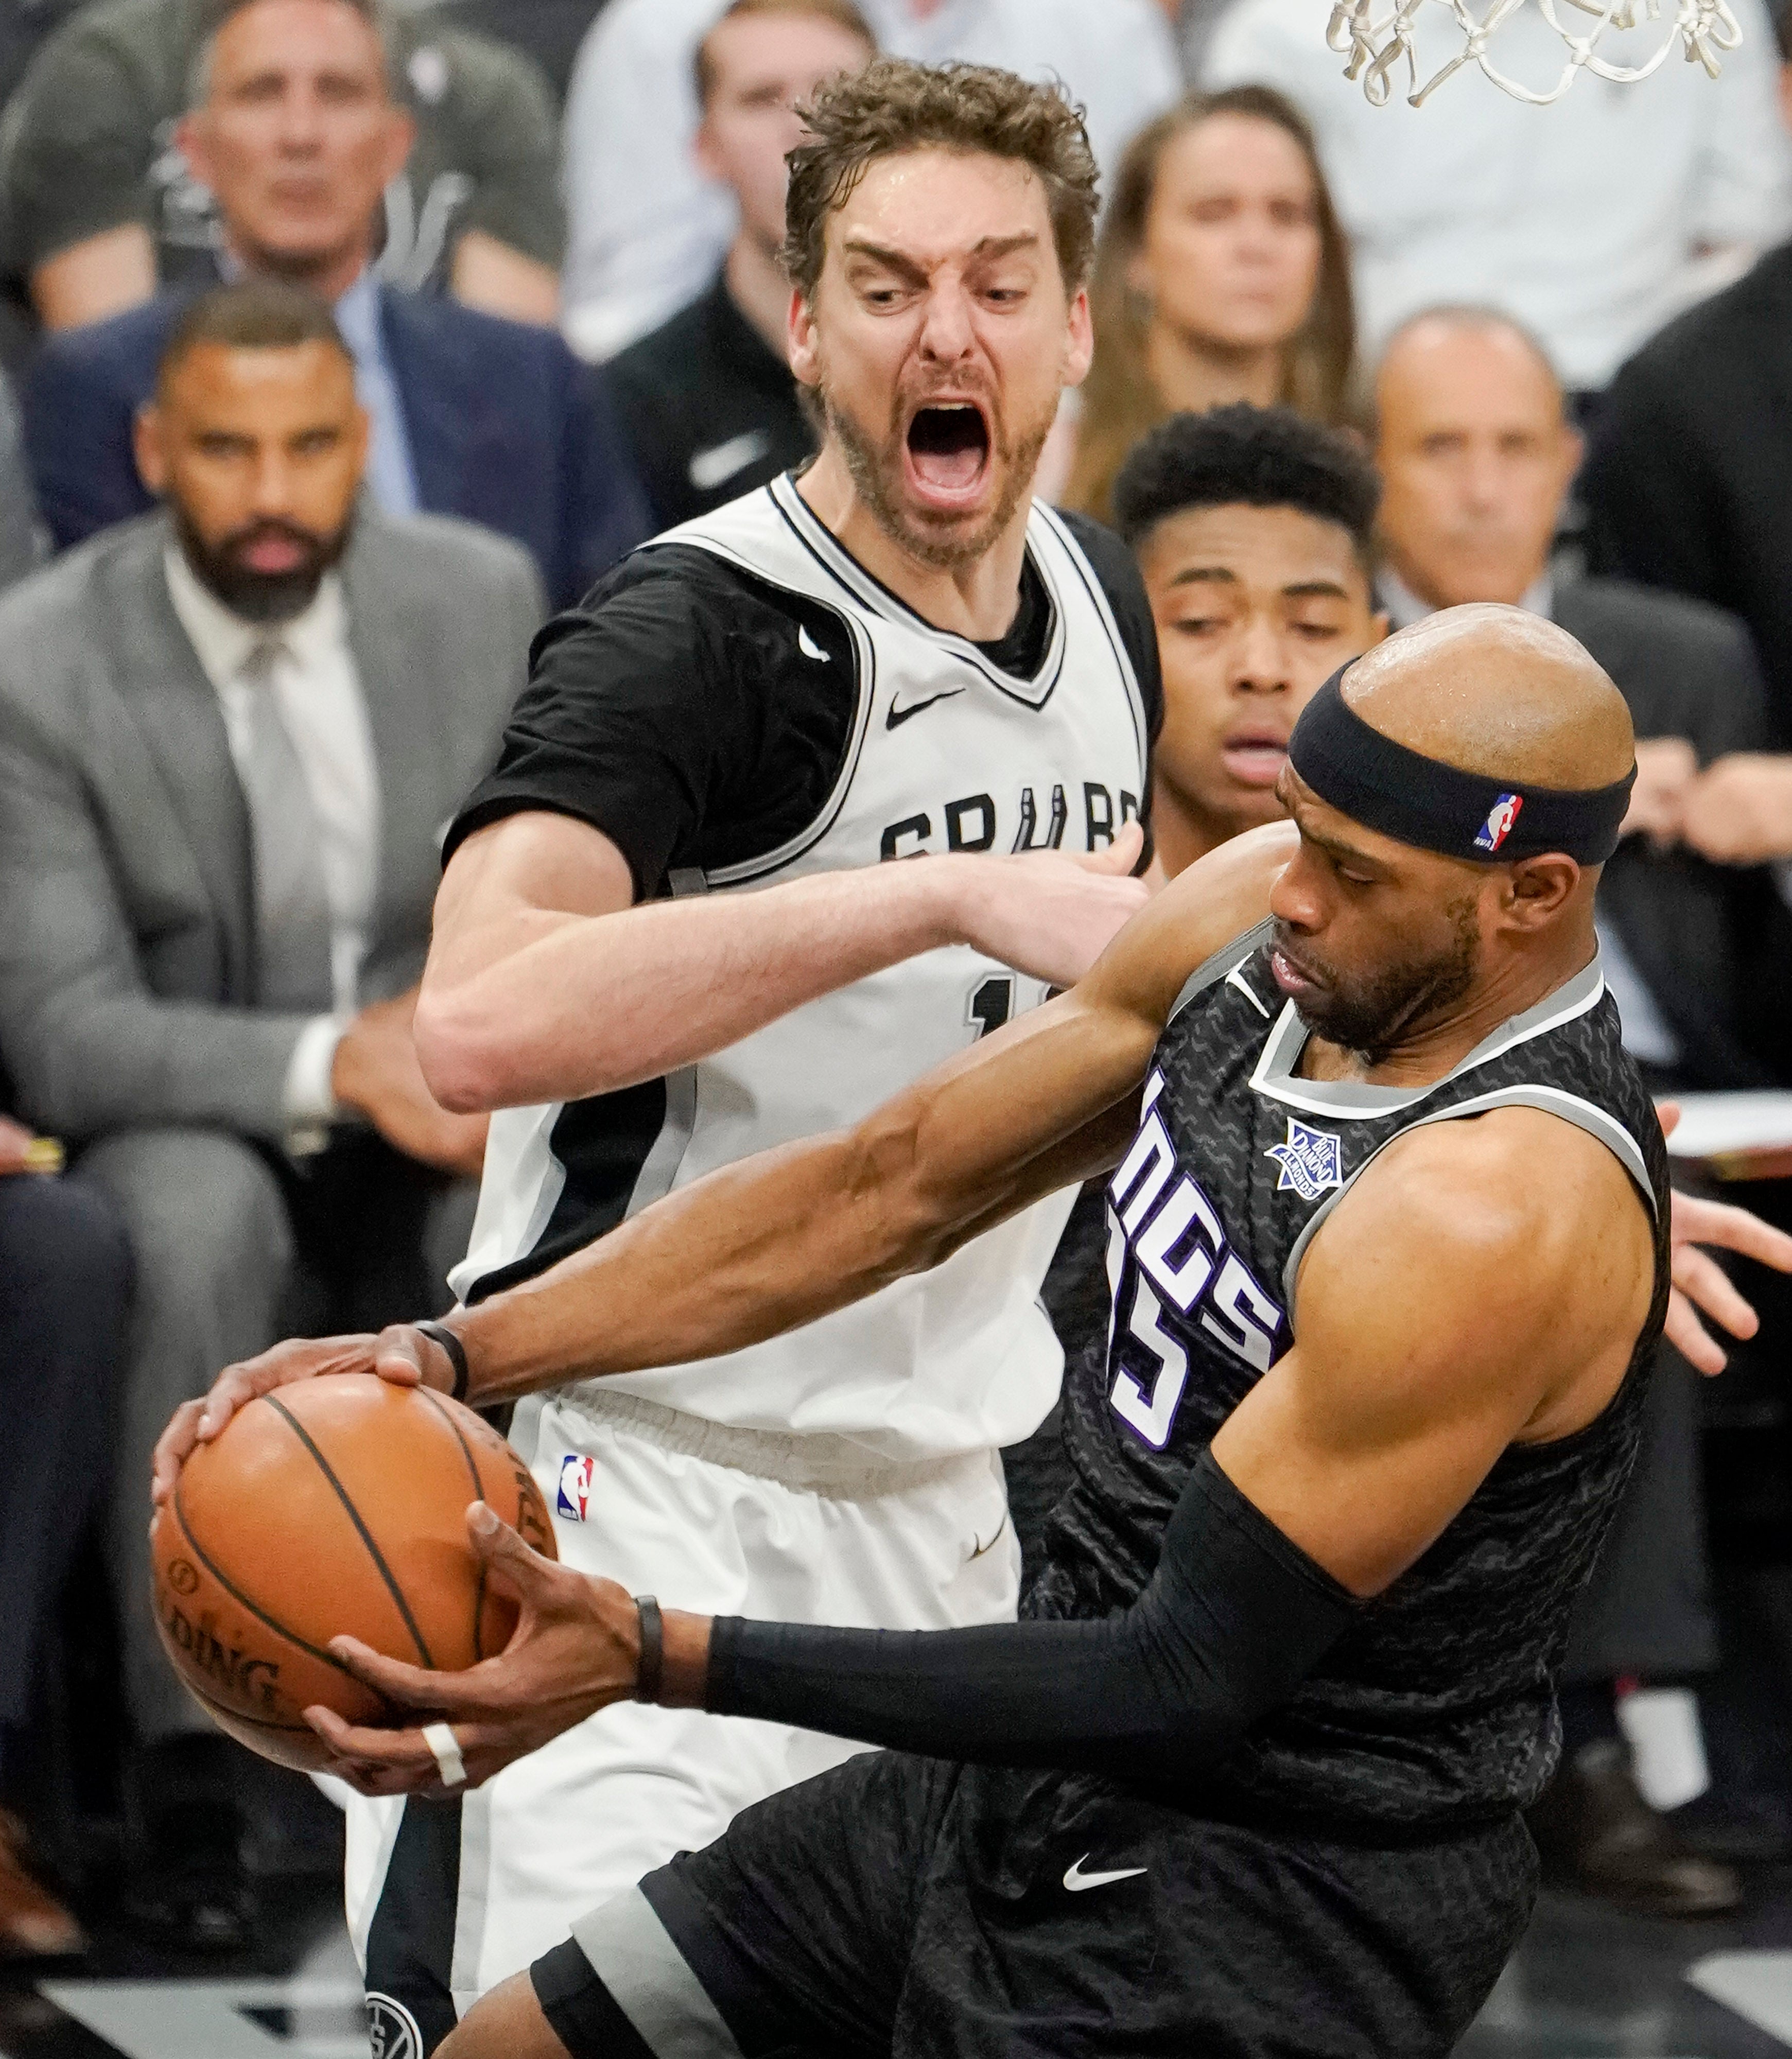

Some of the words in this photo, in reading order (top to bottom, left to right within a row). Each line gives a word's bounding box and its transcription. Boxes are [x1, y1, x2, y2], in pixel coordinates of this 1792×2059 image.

[1279, 1150, 1315, 1196] ALMONDS
[1289, 1132, 1334, 1183] DIAMOND
[1312, 1136, 1335, 1165] BLUE
[163, 1602, 280, 1706] DING
